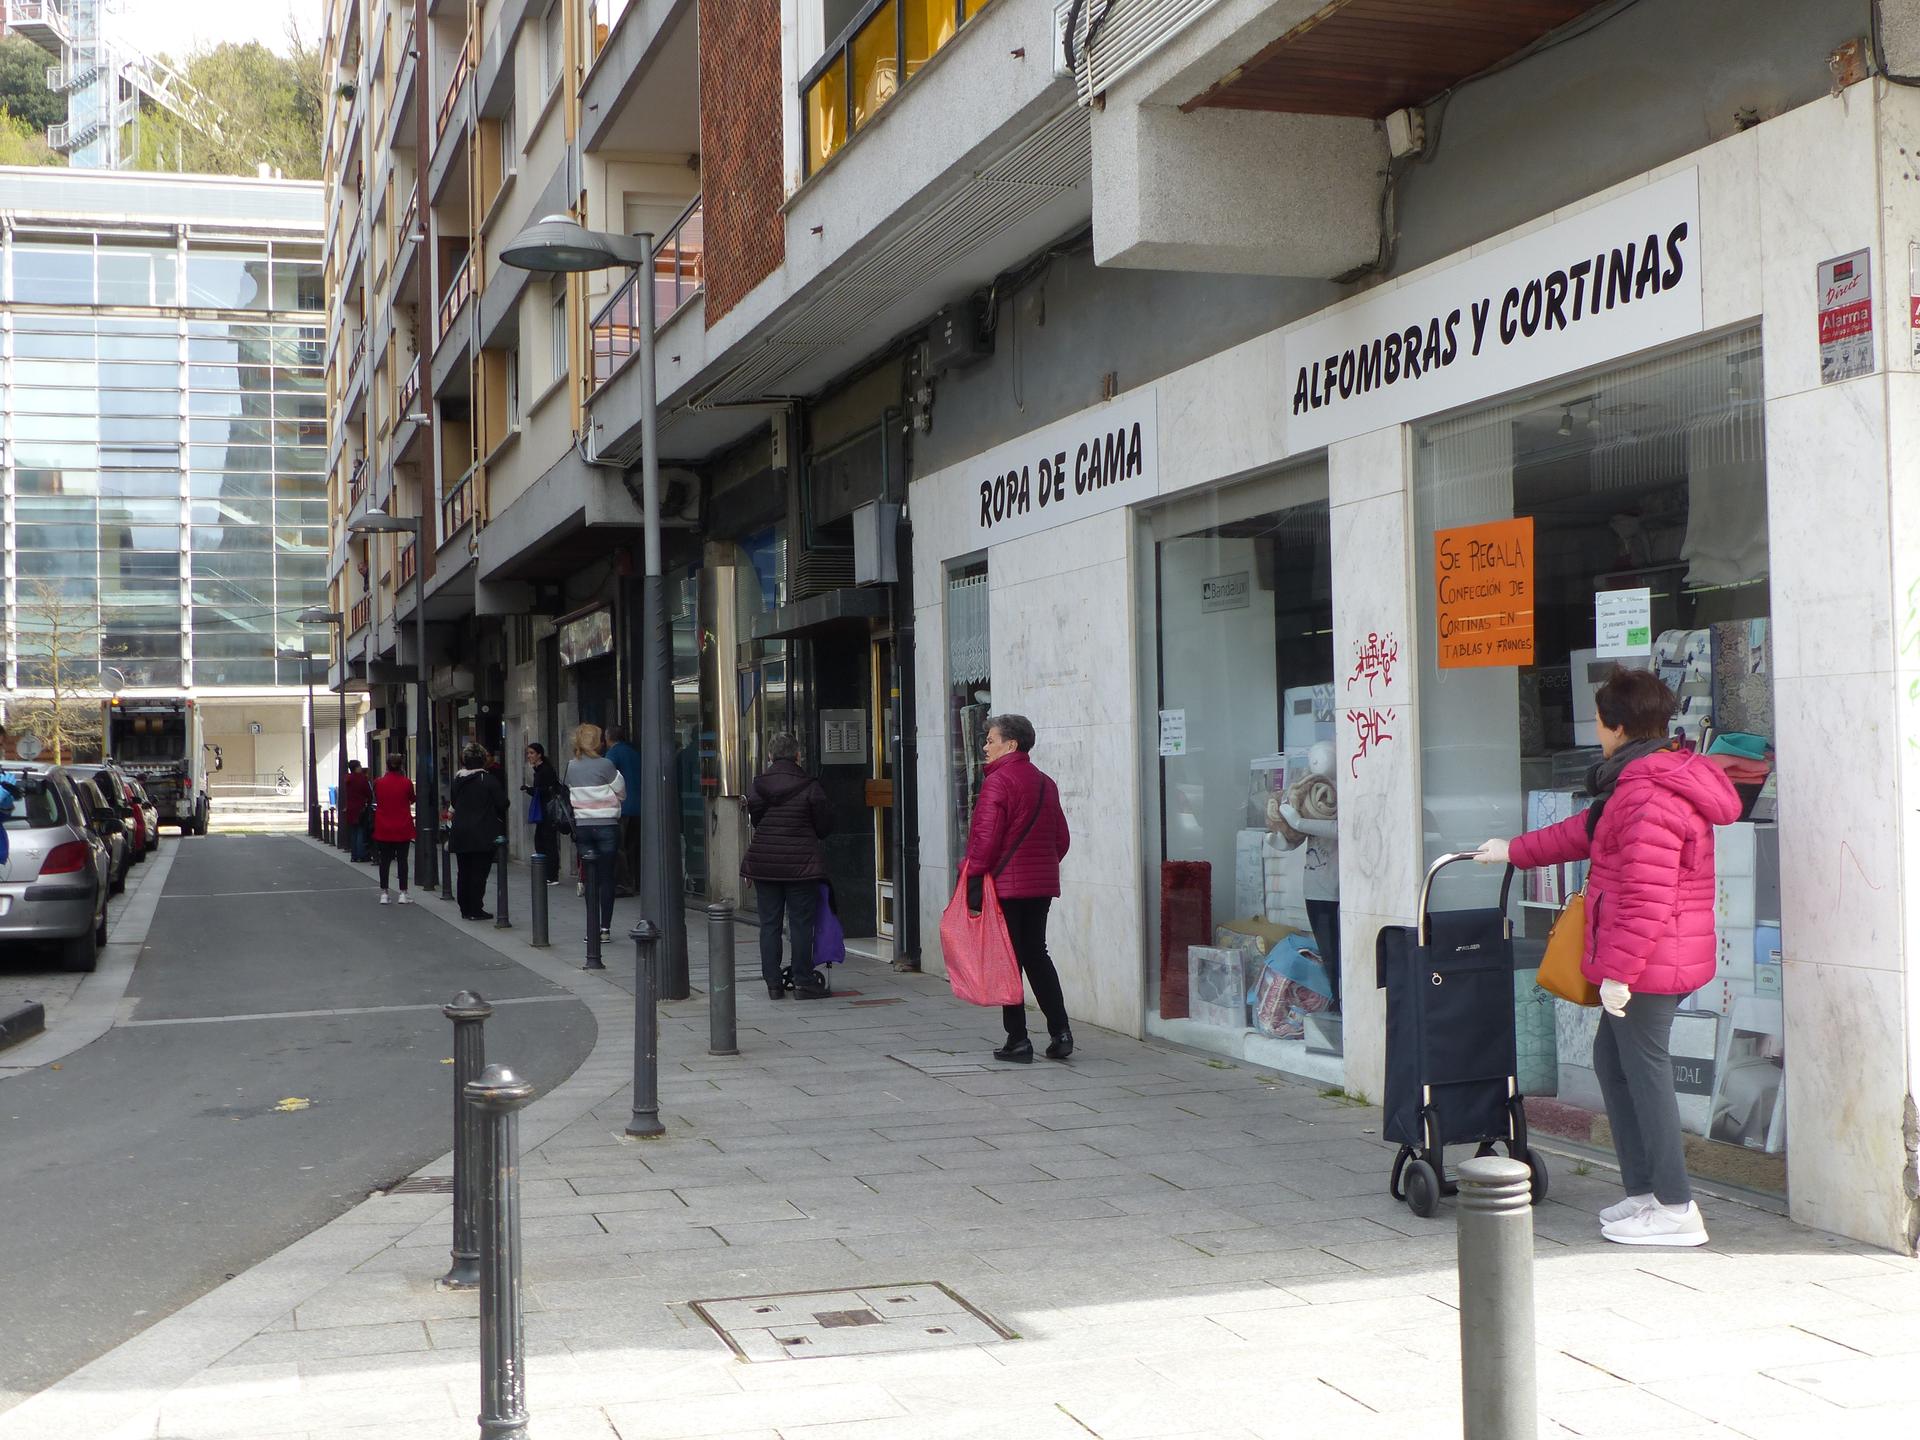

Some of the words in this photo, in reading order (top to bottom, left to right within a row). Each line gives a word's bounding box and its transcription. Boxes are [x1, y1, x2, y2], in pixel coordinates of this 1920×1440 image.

[1826, 273, 1863, 306] Direct
[1293, 307, 1461, 416] ALFOMBRAS
[1469, 297, 1491, 357] Y
[1499, 221, 1689, 347] CORTINAS
[1823, 308, 1868, 332] Alarma
[979, 466, 1032, 530] ROPA
[1038, 451, 1067, 505] DE
[1074, 422, 1143, 493] CAMA
[1467, 537, 1525, 572] REGALA
[1509, 580, 1525, 597] DE
[1439, 612, 1491, 639] CORTINAS
[1500, 611, 1516, 627] EN
[1444, 641, 1483, 659] TABLAS
[1486, 641, 1493, 655] Y
[1496, 638, 1532, 652] FRONCES
